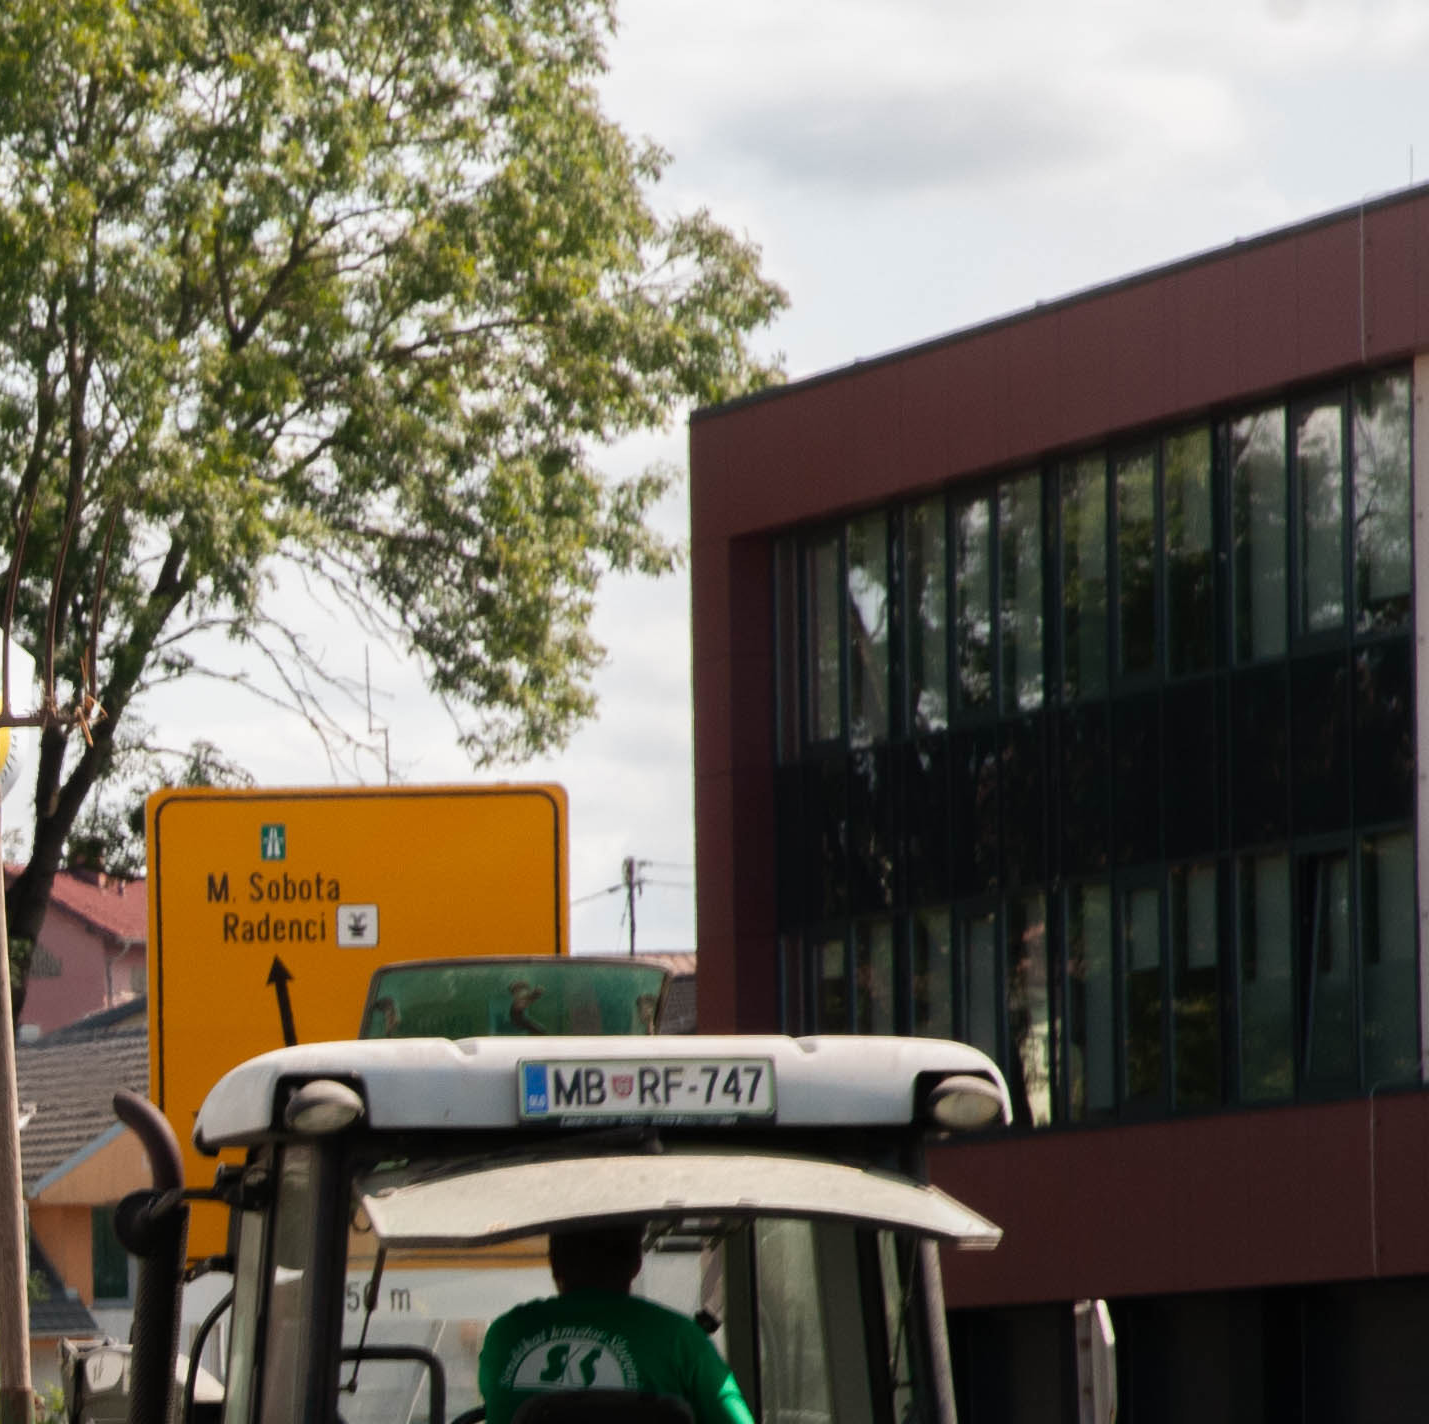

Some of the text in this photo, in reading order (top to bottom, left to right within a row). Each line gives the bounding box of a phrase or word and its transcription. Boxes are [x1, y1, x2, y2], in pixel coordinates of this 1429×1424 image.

[207, 871, 340, 902] M. Sobota
[223, 911, 326, 942] Radenci
[553, 1066, 607, 1106] MB
[638, 1065, 763, 1105] RF-747
